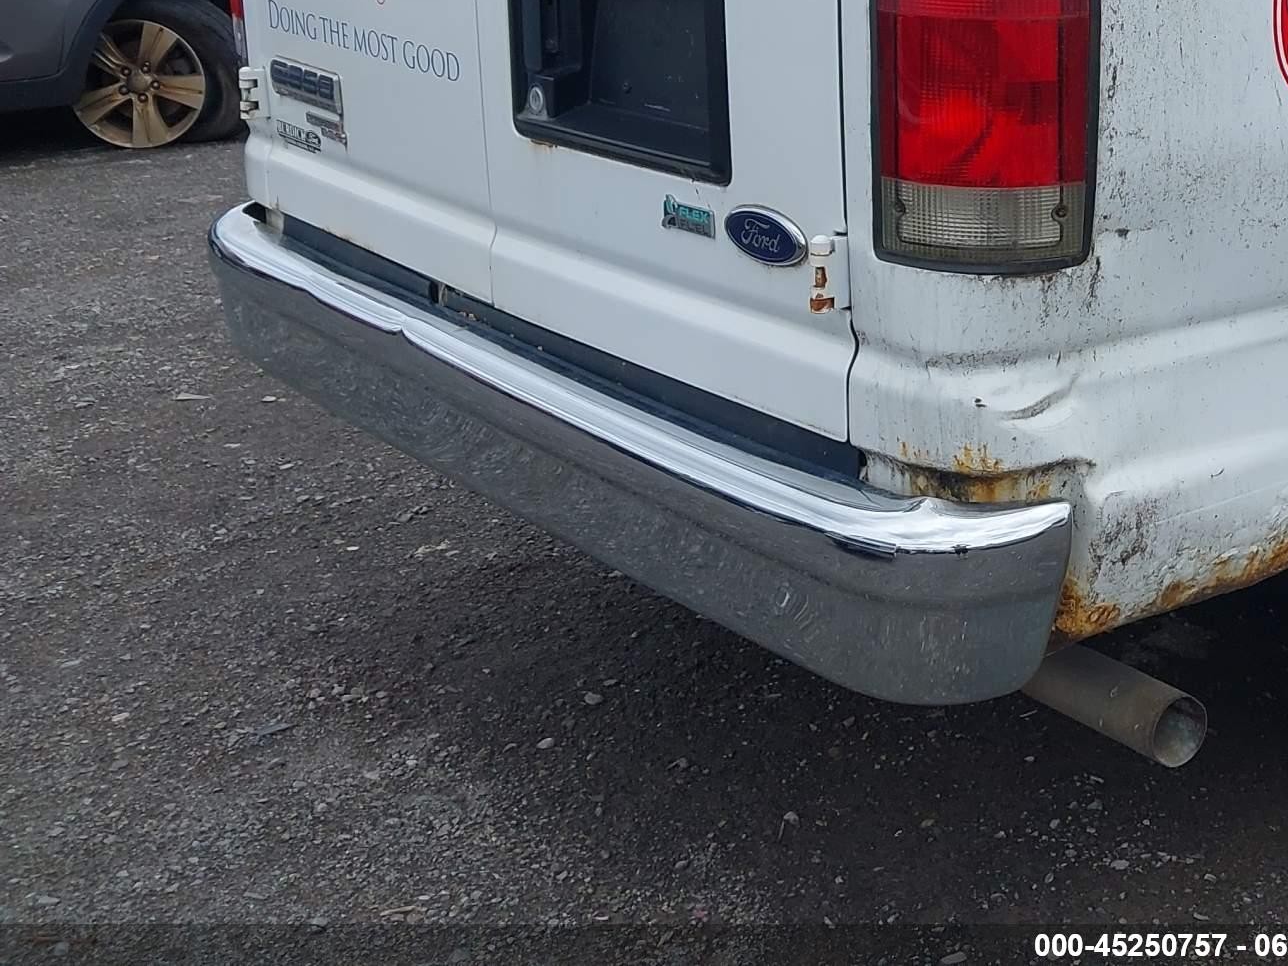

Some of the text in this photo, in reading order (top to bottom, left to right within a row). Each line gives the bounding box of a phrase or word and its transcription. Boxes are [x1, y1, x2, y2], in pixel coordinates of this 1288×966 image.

[268, 0, 460, 82] DOING THE MOST GOOD
[679, 206, 709, 225] FLEX
[740, 218, 781, 254] Ford
